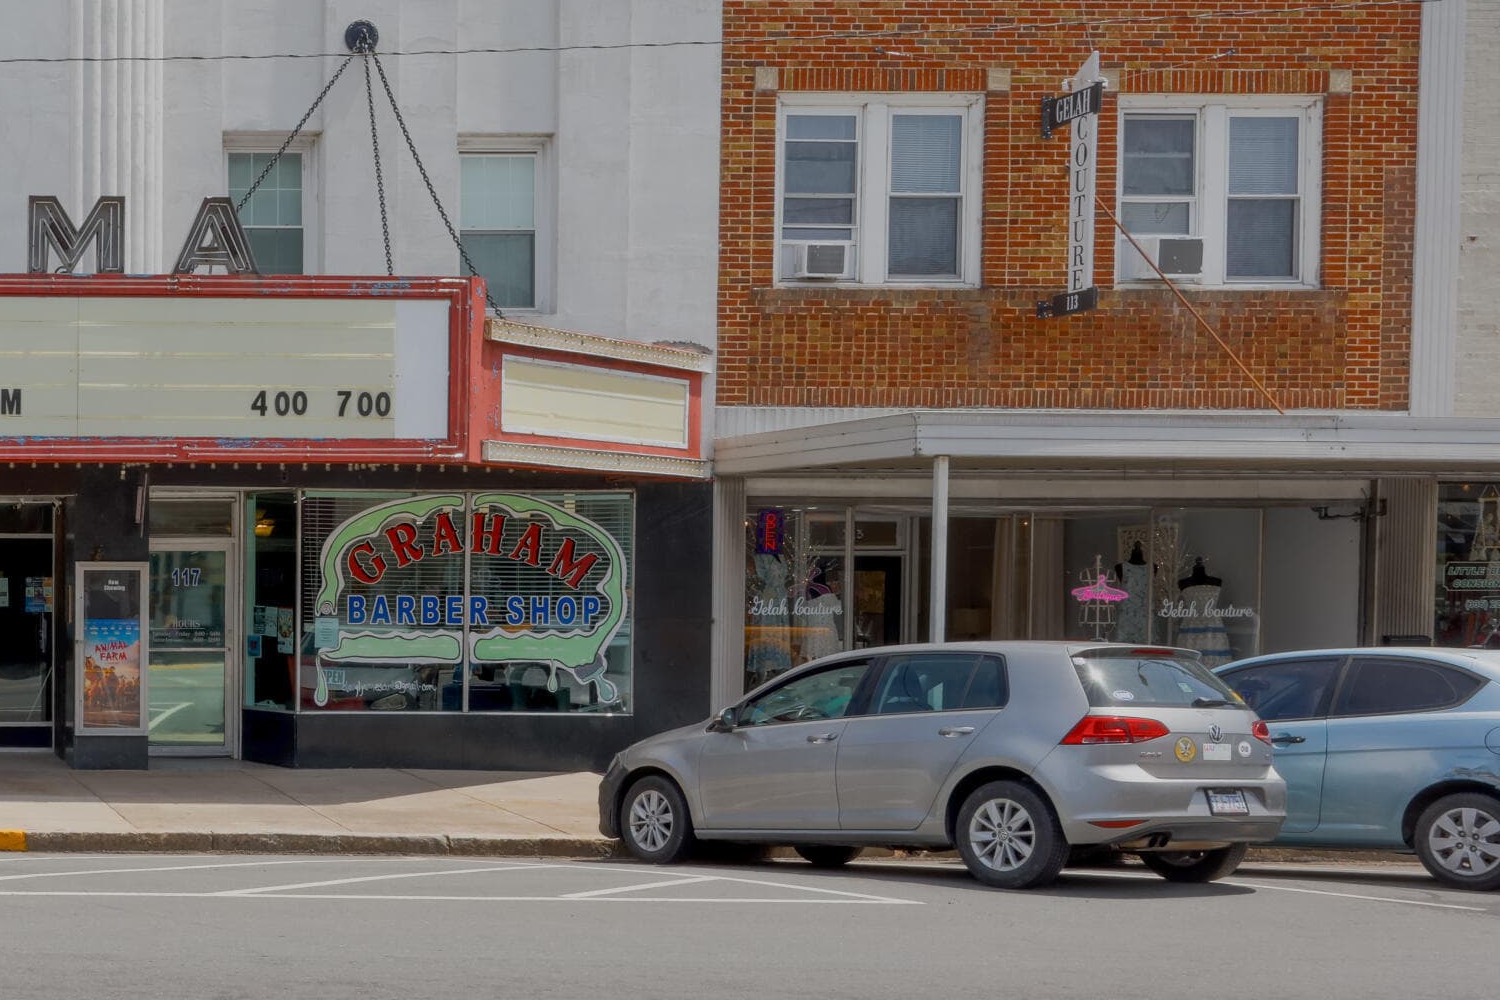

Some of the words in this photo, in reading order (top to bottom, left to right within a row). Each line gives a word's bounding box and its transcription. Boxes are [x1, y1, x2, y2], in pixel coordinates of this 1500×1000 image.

[1056, 88, 1090, 123] GELAH
[1072, 116, 1088, 291] COUTURE
[1066, 294, 1079, 311] 113
[250, 390, 308, 417] 400
[336, 390, 392, 417] 700
[765, 513, 777, 551] OPEN
[347, 511, 601, 591] GRAHAM
[171, 567, 202, 587] 117
[1447, 567, 1485, 575] LITTLE
[347, 595, 489, 625] BARBER
[505, 595, 602, 625] SHOP
[749, 596, 788, 616] Gelah
[792, 596, 844, 616] Couture
[1158, 598, 1198, 618] Gelah
[1203, 599, 1255, 618] Couture
[95, 640, 130, 653] ANIMAL
[100, 652, 127, 661] FARM
